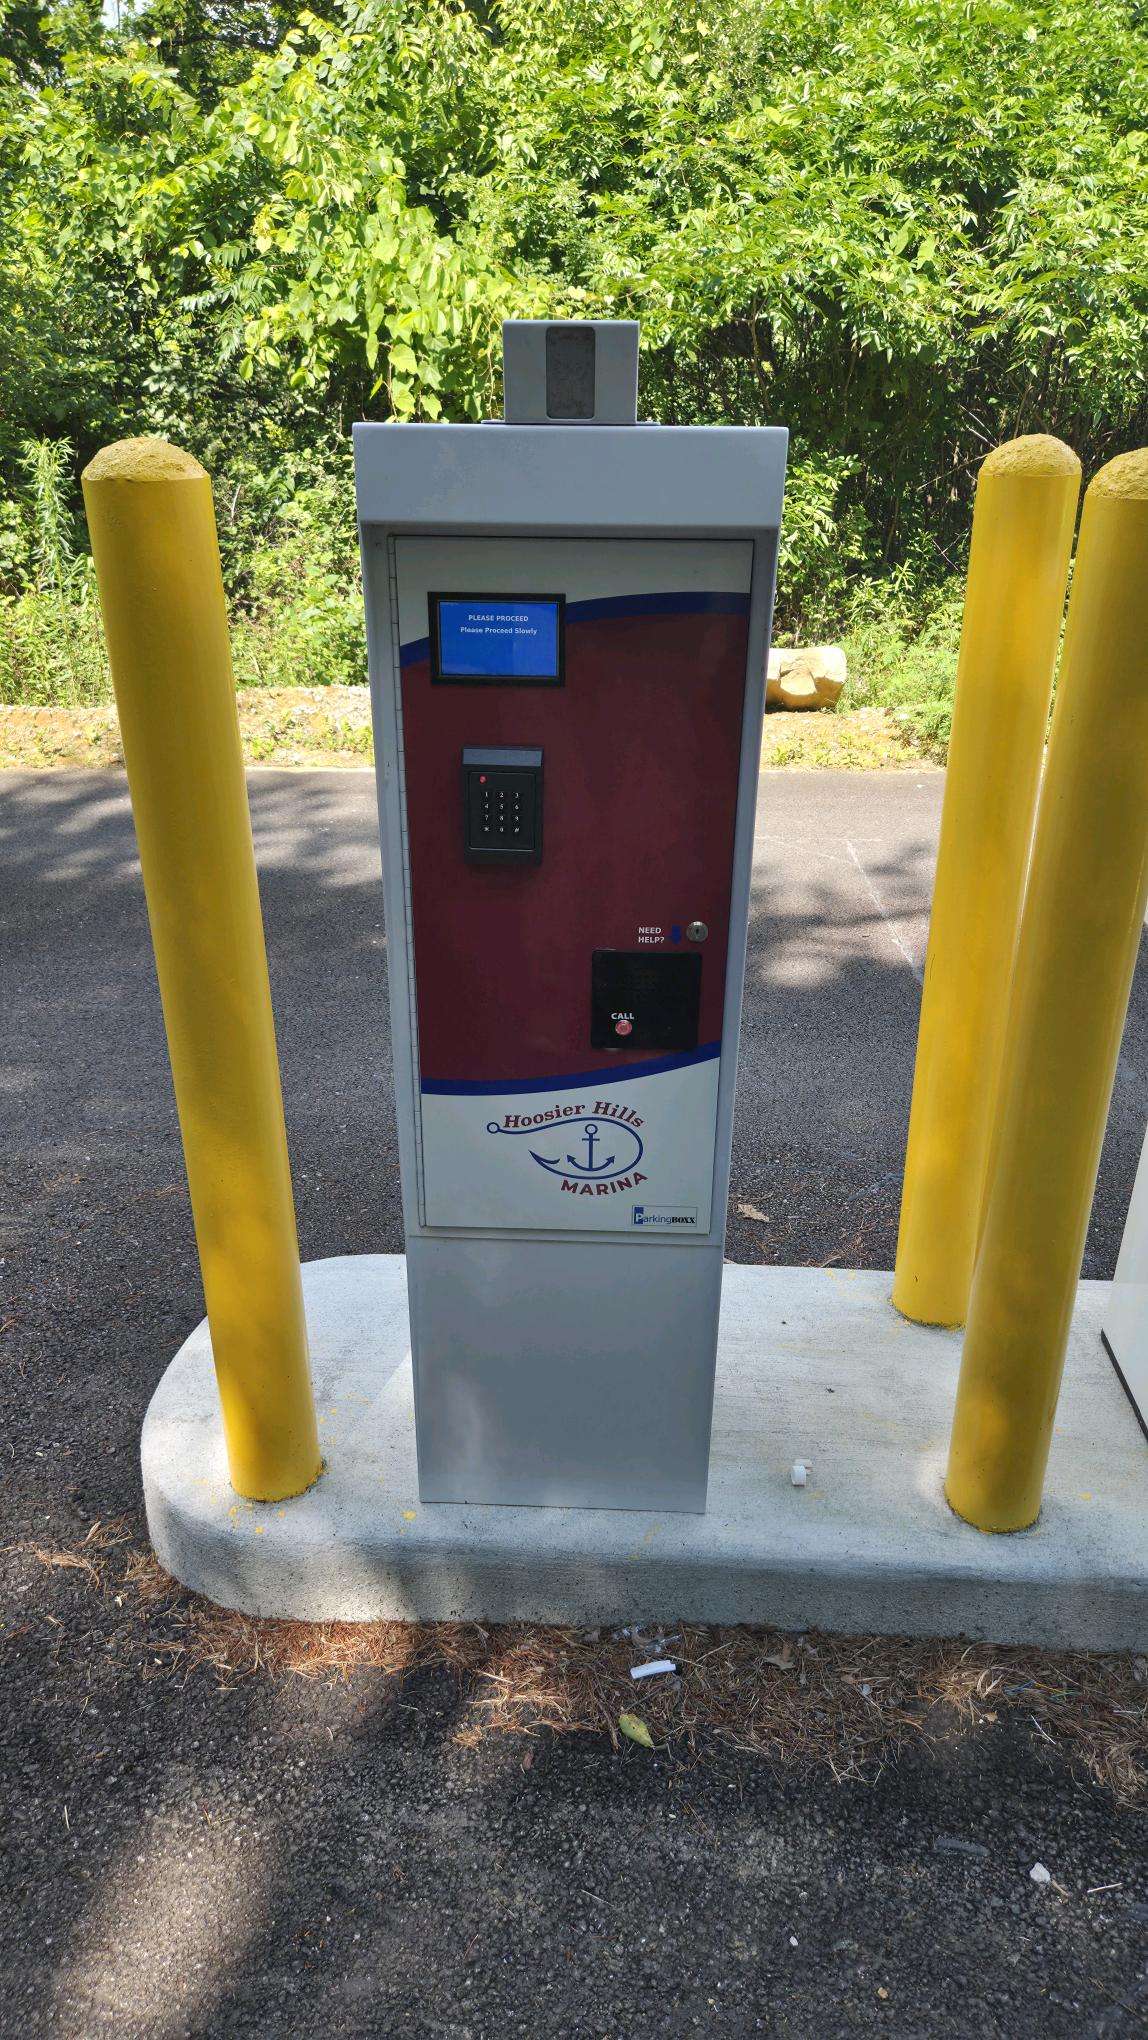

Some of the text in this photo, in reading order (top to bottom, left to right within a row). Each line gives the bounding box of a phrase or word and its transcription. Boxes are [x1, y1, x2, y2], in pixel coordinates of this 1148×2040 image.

[468, 614, 495, 622] PLEASE
[460, 626, 483, 634] Please
[514, 627, 538, 636] Slowly
[638, 936, 665, 944] HELP?
[611, 1012, 635, 1020] CALL
[503, 1101, 645, 1128] Hoosier Hills
[560, 1171, 648, 1195] MARINA
